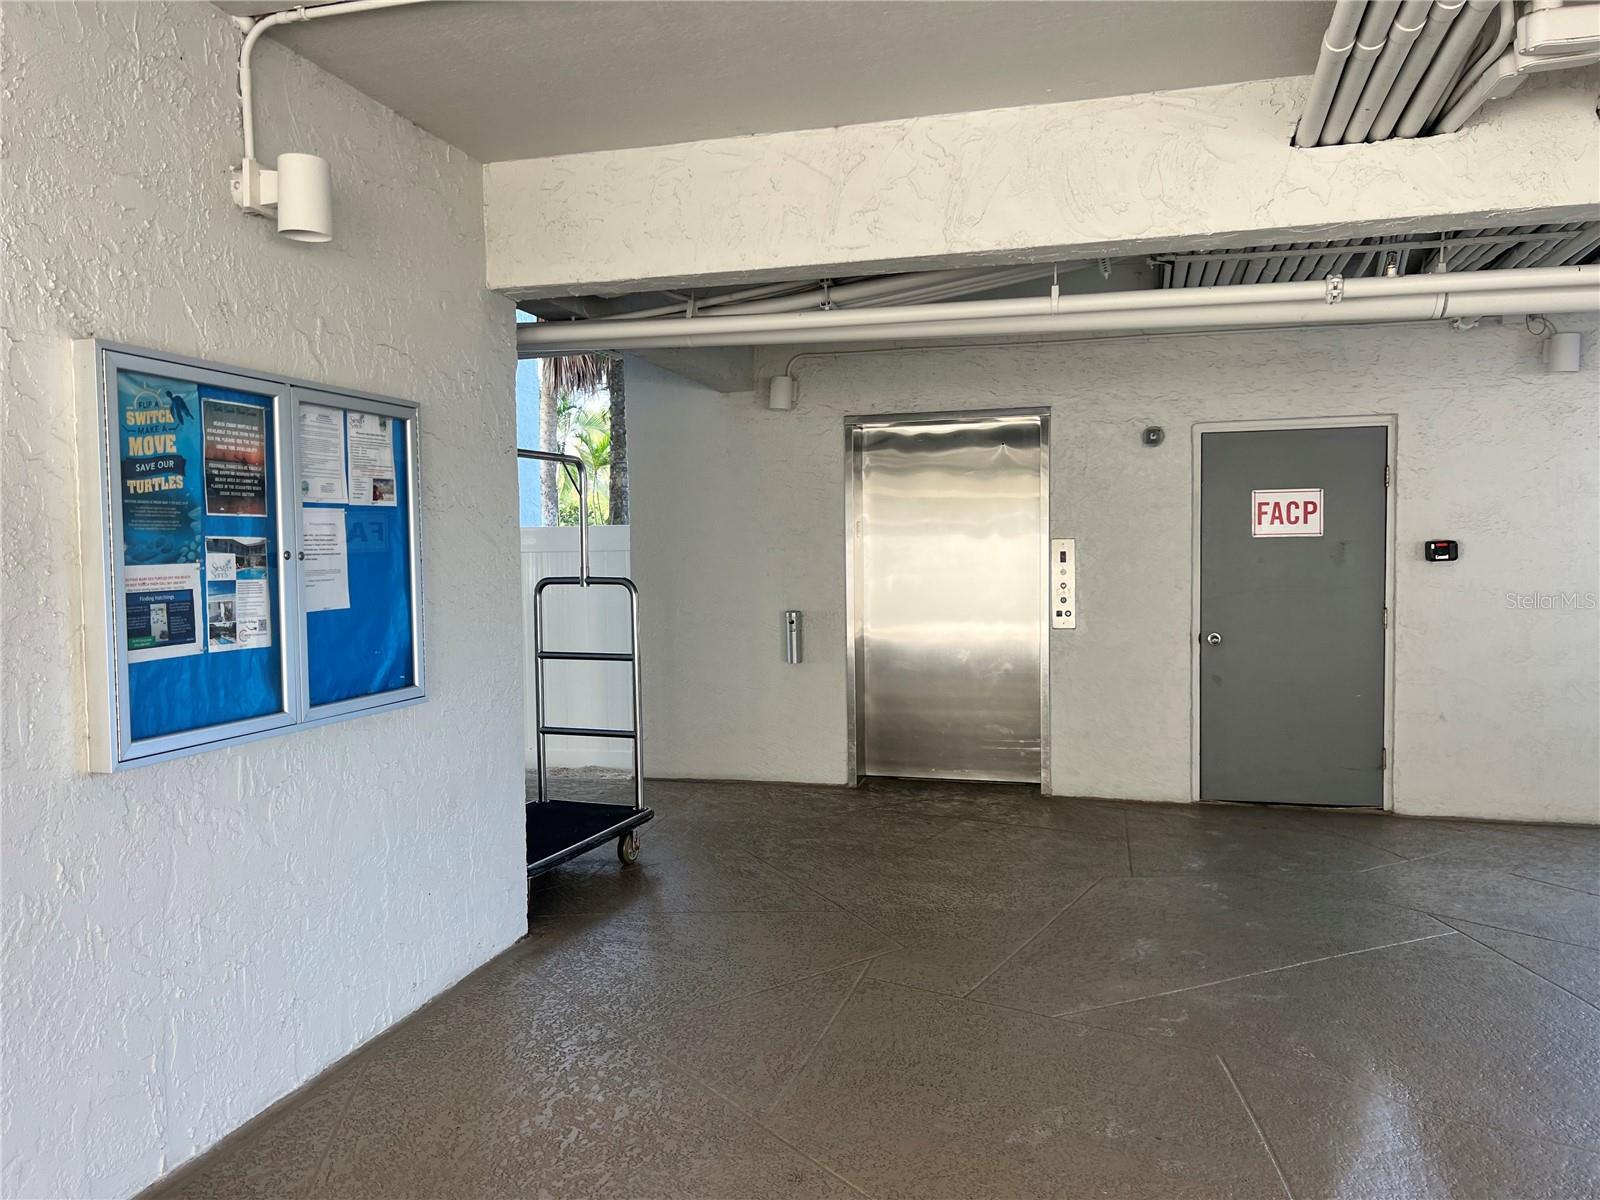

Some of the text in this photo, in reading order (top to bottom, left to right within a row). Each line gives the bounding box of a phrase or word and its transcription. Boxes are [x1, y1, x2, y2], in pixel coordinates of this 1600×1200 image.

[138, 401, 153, 409] FLIP
[137, 425, 161, 433] MAKE
[128, 434, 177, 456] MOVE
[135, 460, 174, 472] SAVE OUR
[127, 475, 184, 494] TURTLES
[1257, 501, 1318, 525] FACP
